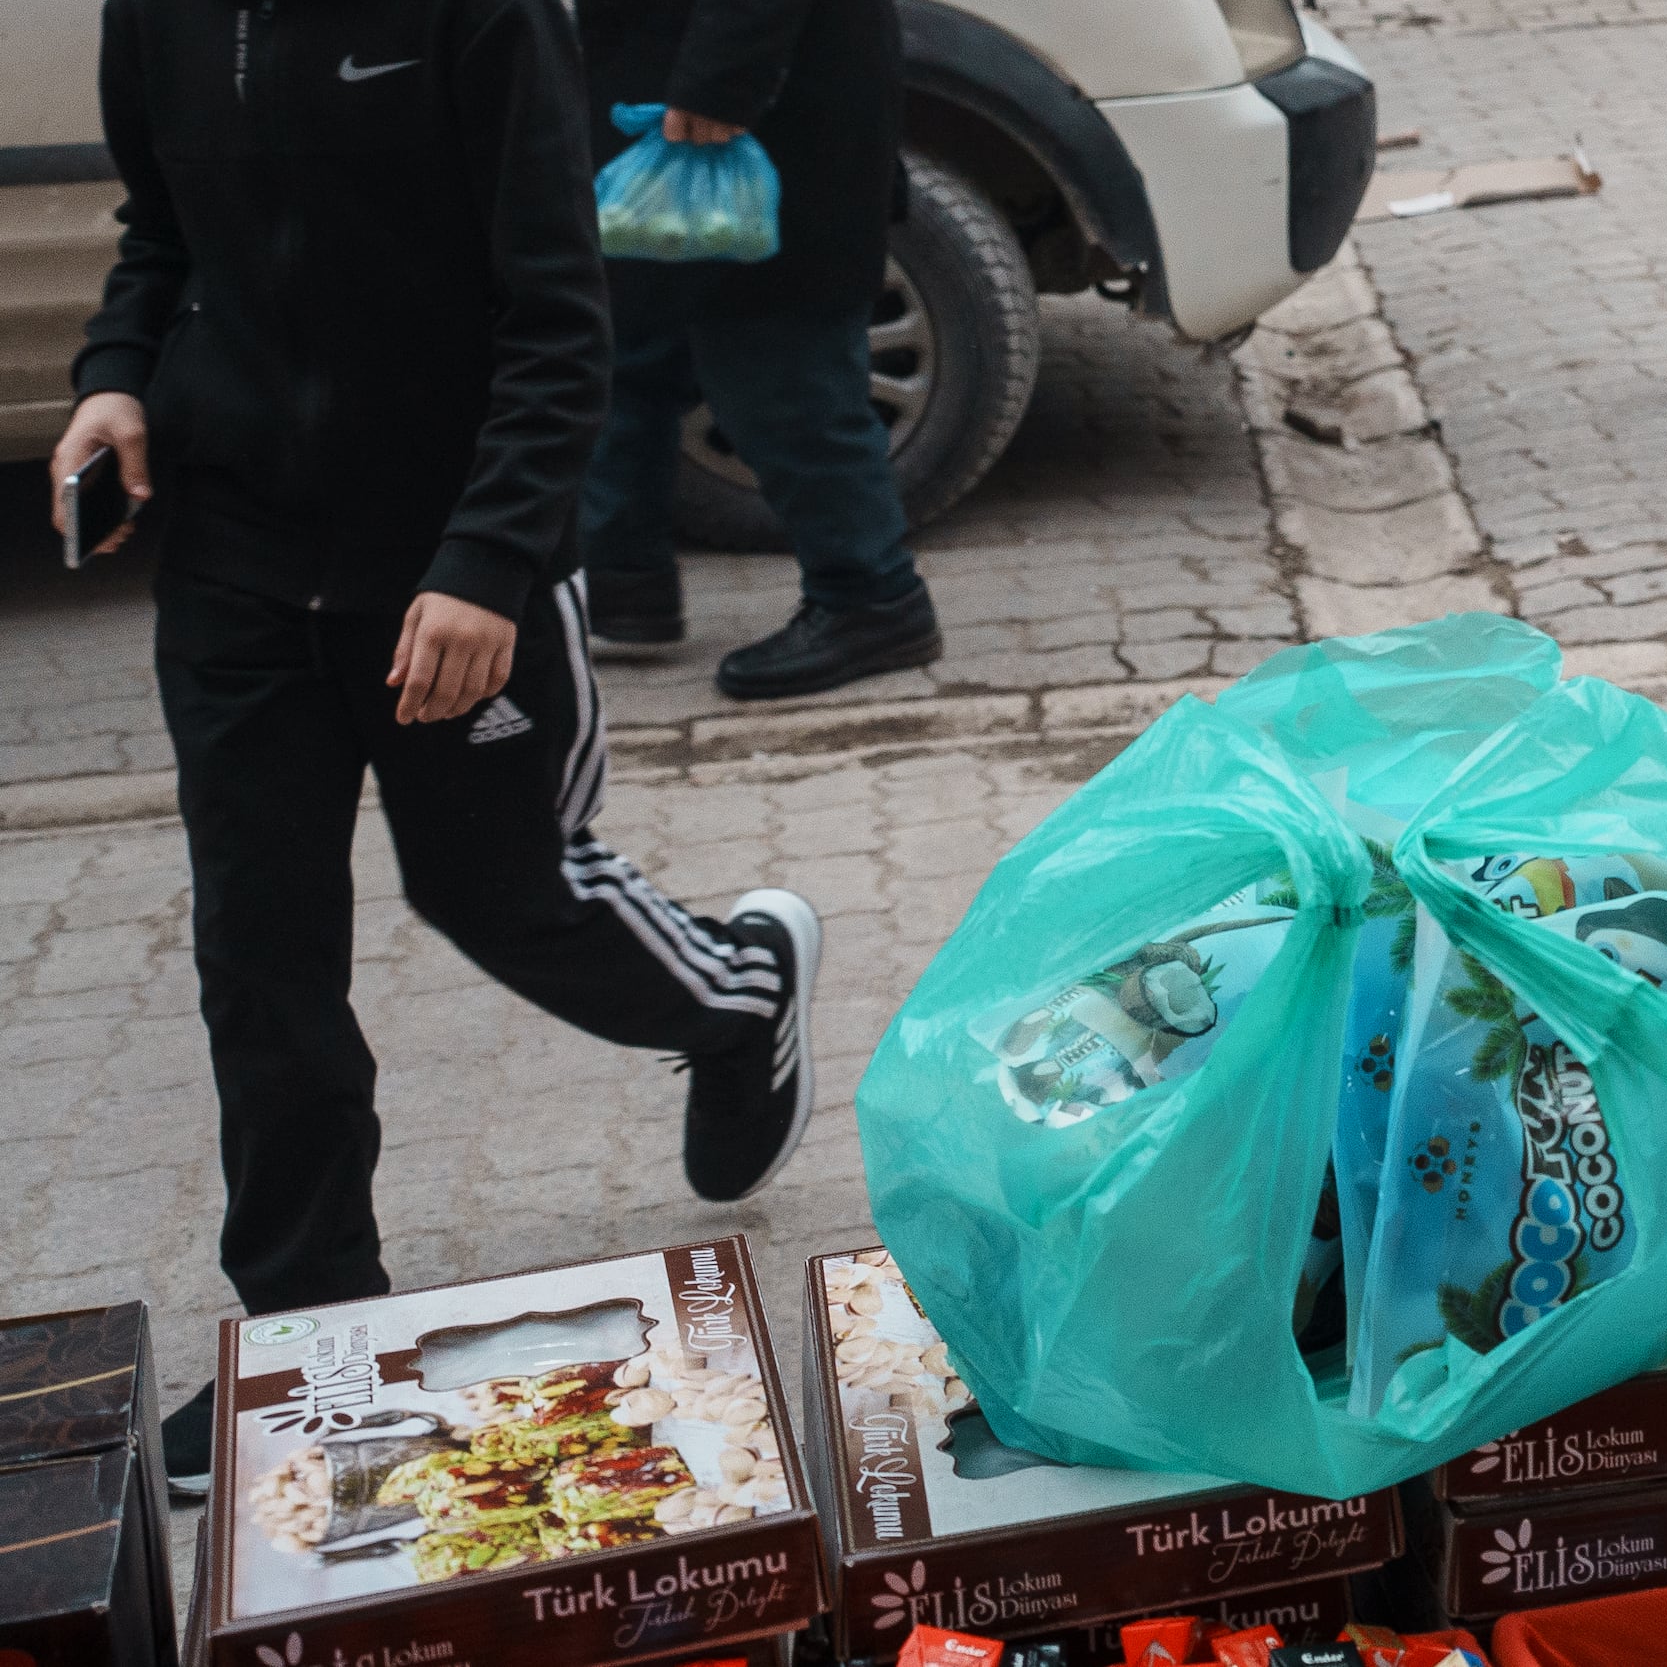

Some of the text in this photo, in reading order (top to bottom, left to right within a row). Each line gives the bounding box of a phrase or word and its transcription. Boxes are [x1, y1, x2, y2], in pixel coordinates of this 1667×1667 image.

[1585, 1427, 1646, 1451] Lokum
[1502, 1426, 1586, 1486] ELİS
[1585, 1450, 1659, 1475] Dünyası
[1124, 1494, 1368, 1558] Türk Lokumu
[1596, 1535, 1656, 1560] Lokum
[1510, 1535, 1596, 1595] ELİS
[521, 1551, 790, 1624] Türk Lokumu
[999, 1571, 1063, 1598] Lokum
[1000, 1592, 1079, 1621] Dünyası
[943, 1638, 988, 1660] Ender
[1300, 1650, 1345, 1667] Ender
